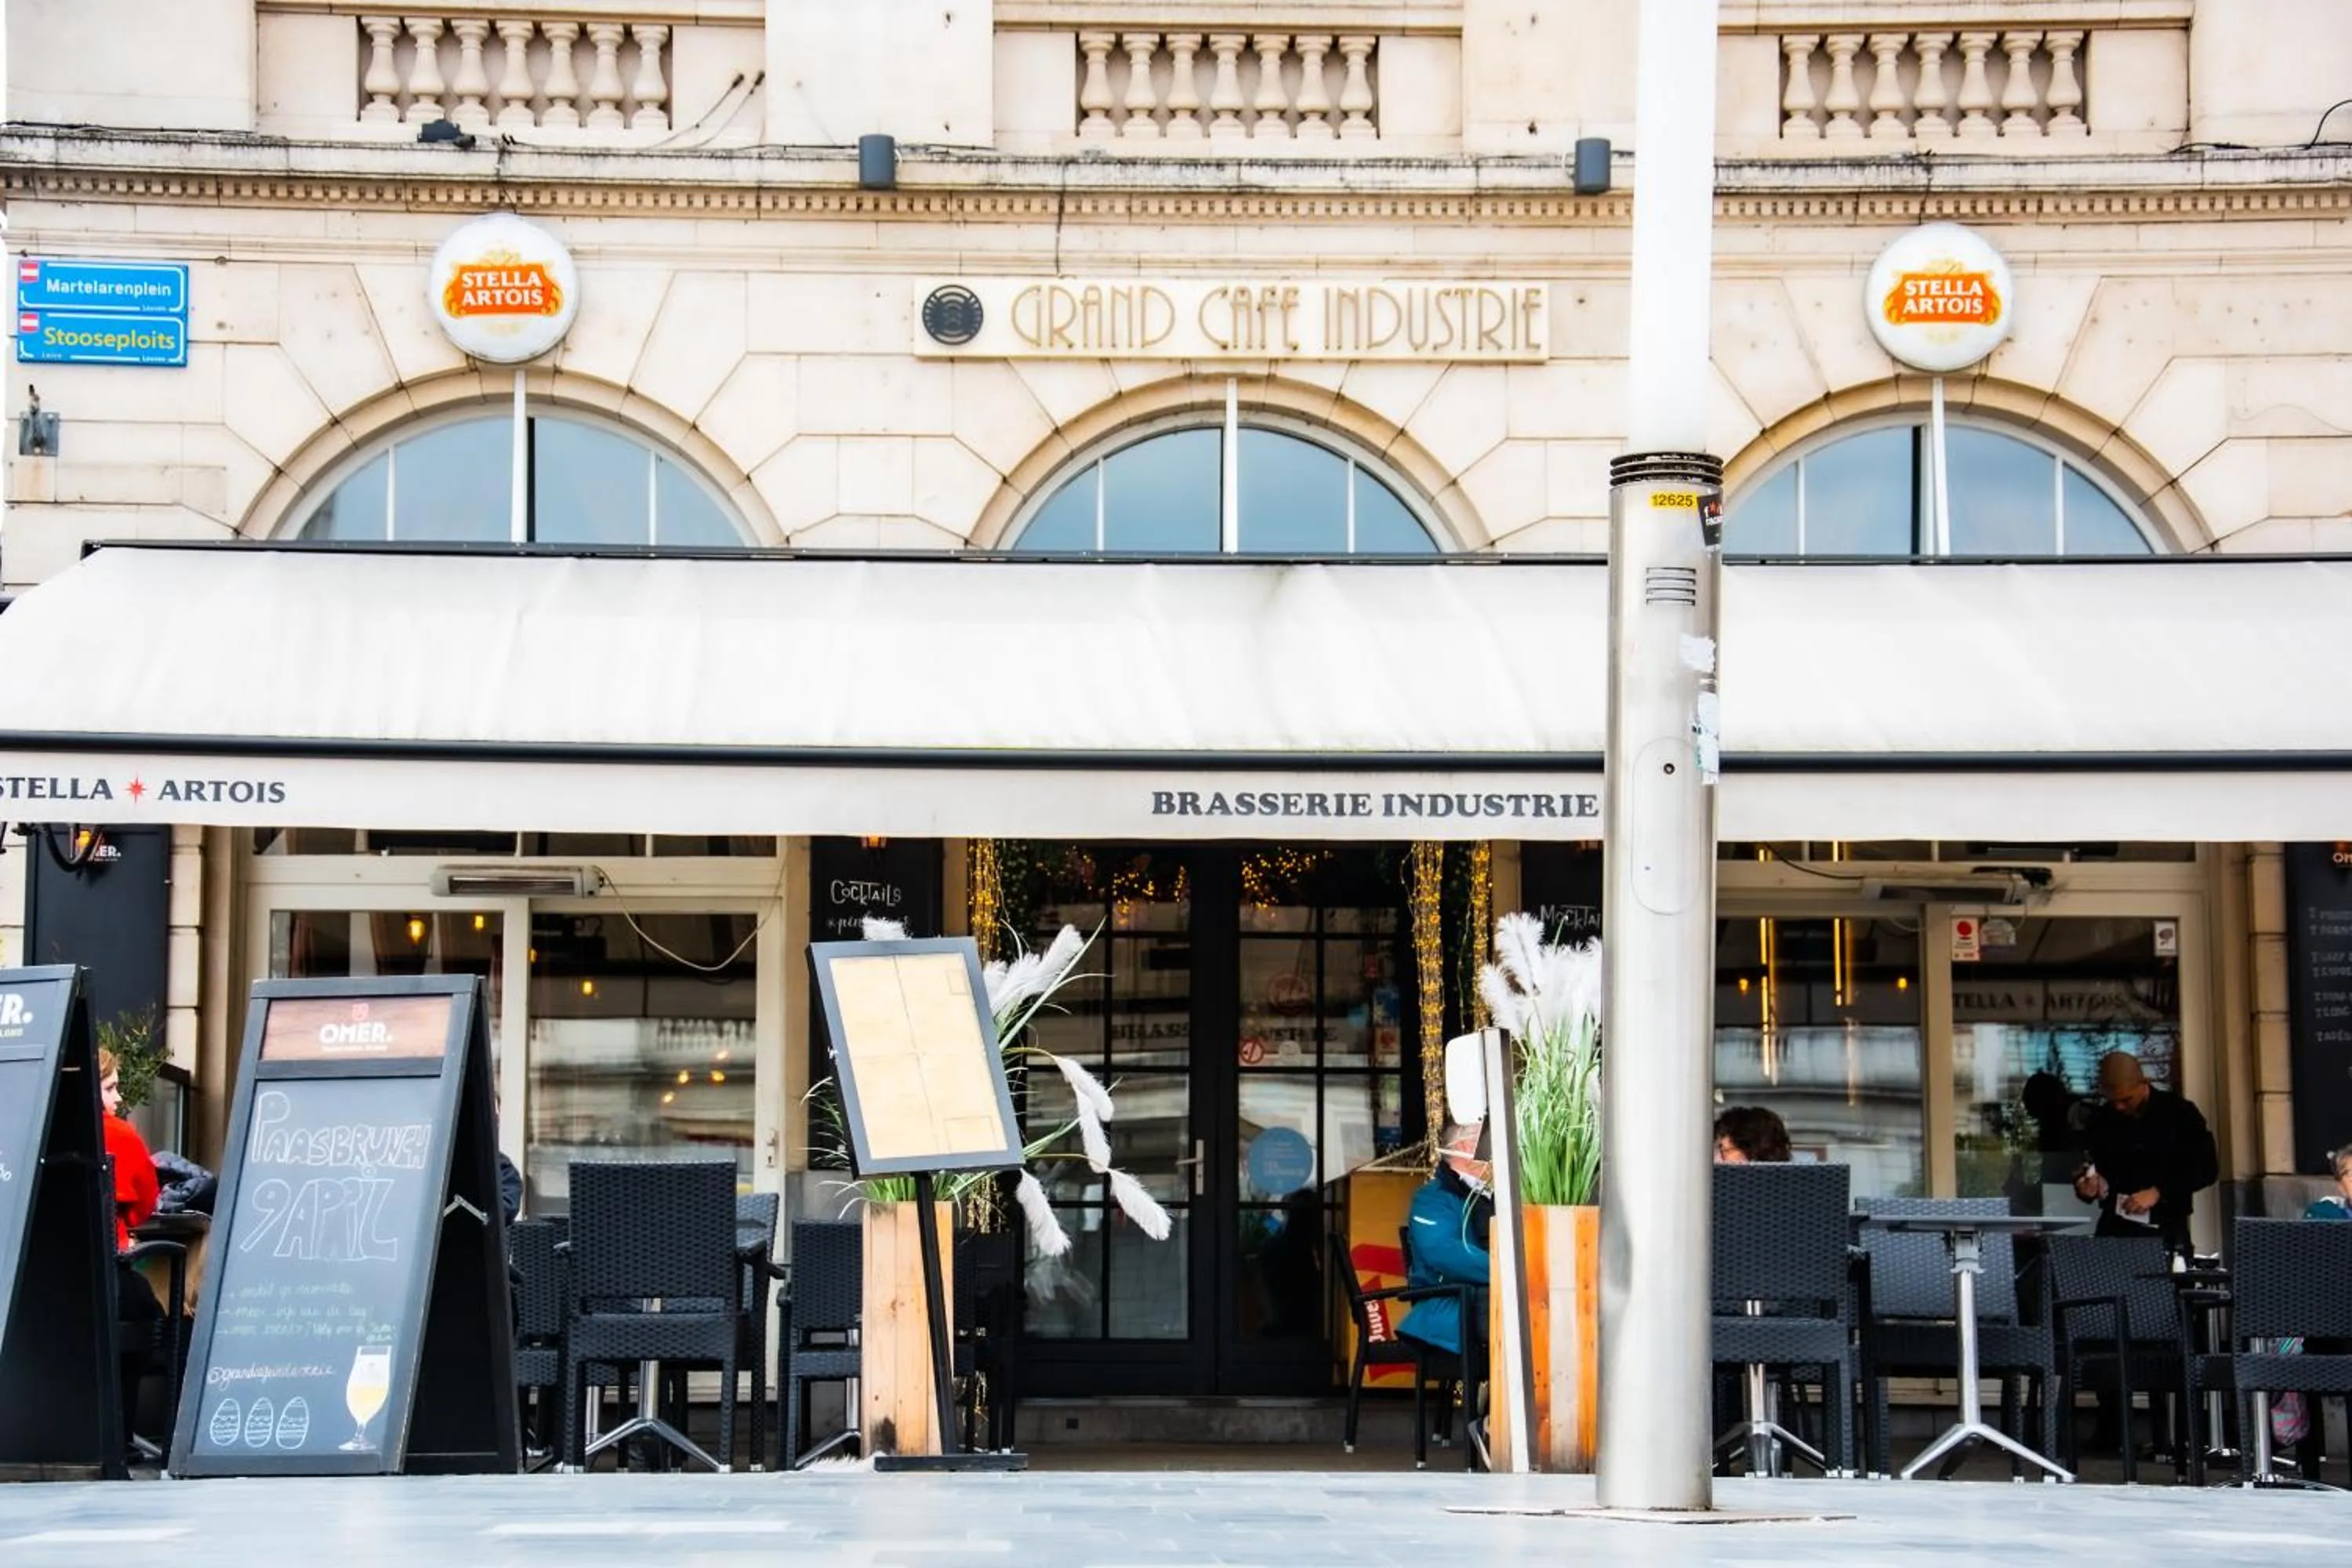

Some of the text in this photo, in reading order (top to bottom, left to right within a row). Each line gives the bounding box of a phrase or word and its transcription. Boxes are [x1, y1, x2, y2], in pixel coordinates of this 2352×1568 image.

[46, 279, 172, 298] Martelarenplein
[461, 270, 543, 289] STELLA
[1904, 279, 1984, 296] STELLA
[461, 288, 543, 307] ARTOIS
[1903, 296, 1984, 314] ARTOIS
[1010, 284, 1176, 350] GRAND
[1323, 285, 1544, 351] INDUSTRIE
[43, 326, 176, 351] Stooseploits
[1651, 492, 1693, 507] 12625
[158, 779, 286, 804] ARTOIS
[1152, 790, 1599, 818] BRASSERIE INDUSTRIE
[319, 1022, 393, 1044] OMER.
